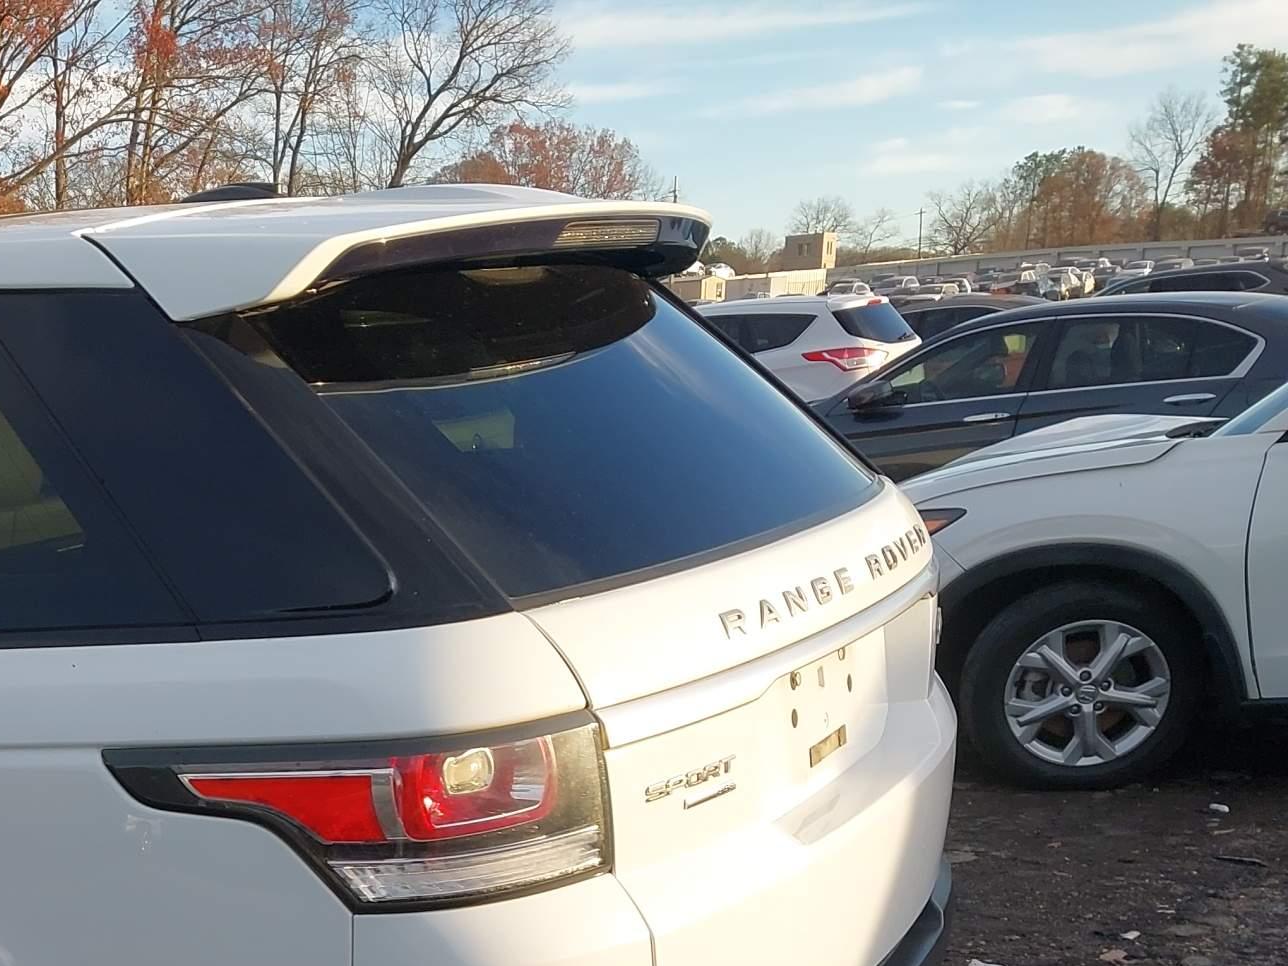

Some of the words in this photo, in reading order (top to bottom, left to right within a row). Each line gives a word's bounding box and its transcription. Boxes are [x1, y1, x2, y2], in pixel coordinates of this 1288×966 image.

[718, 567, 855, 639] RANGE
[865, 524, 927, 580] ROVER
[645, 754, 736, 802] SPORT
